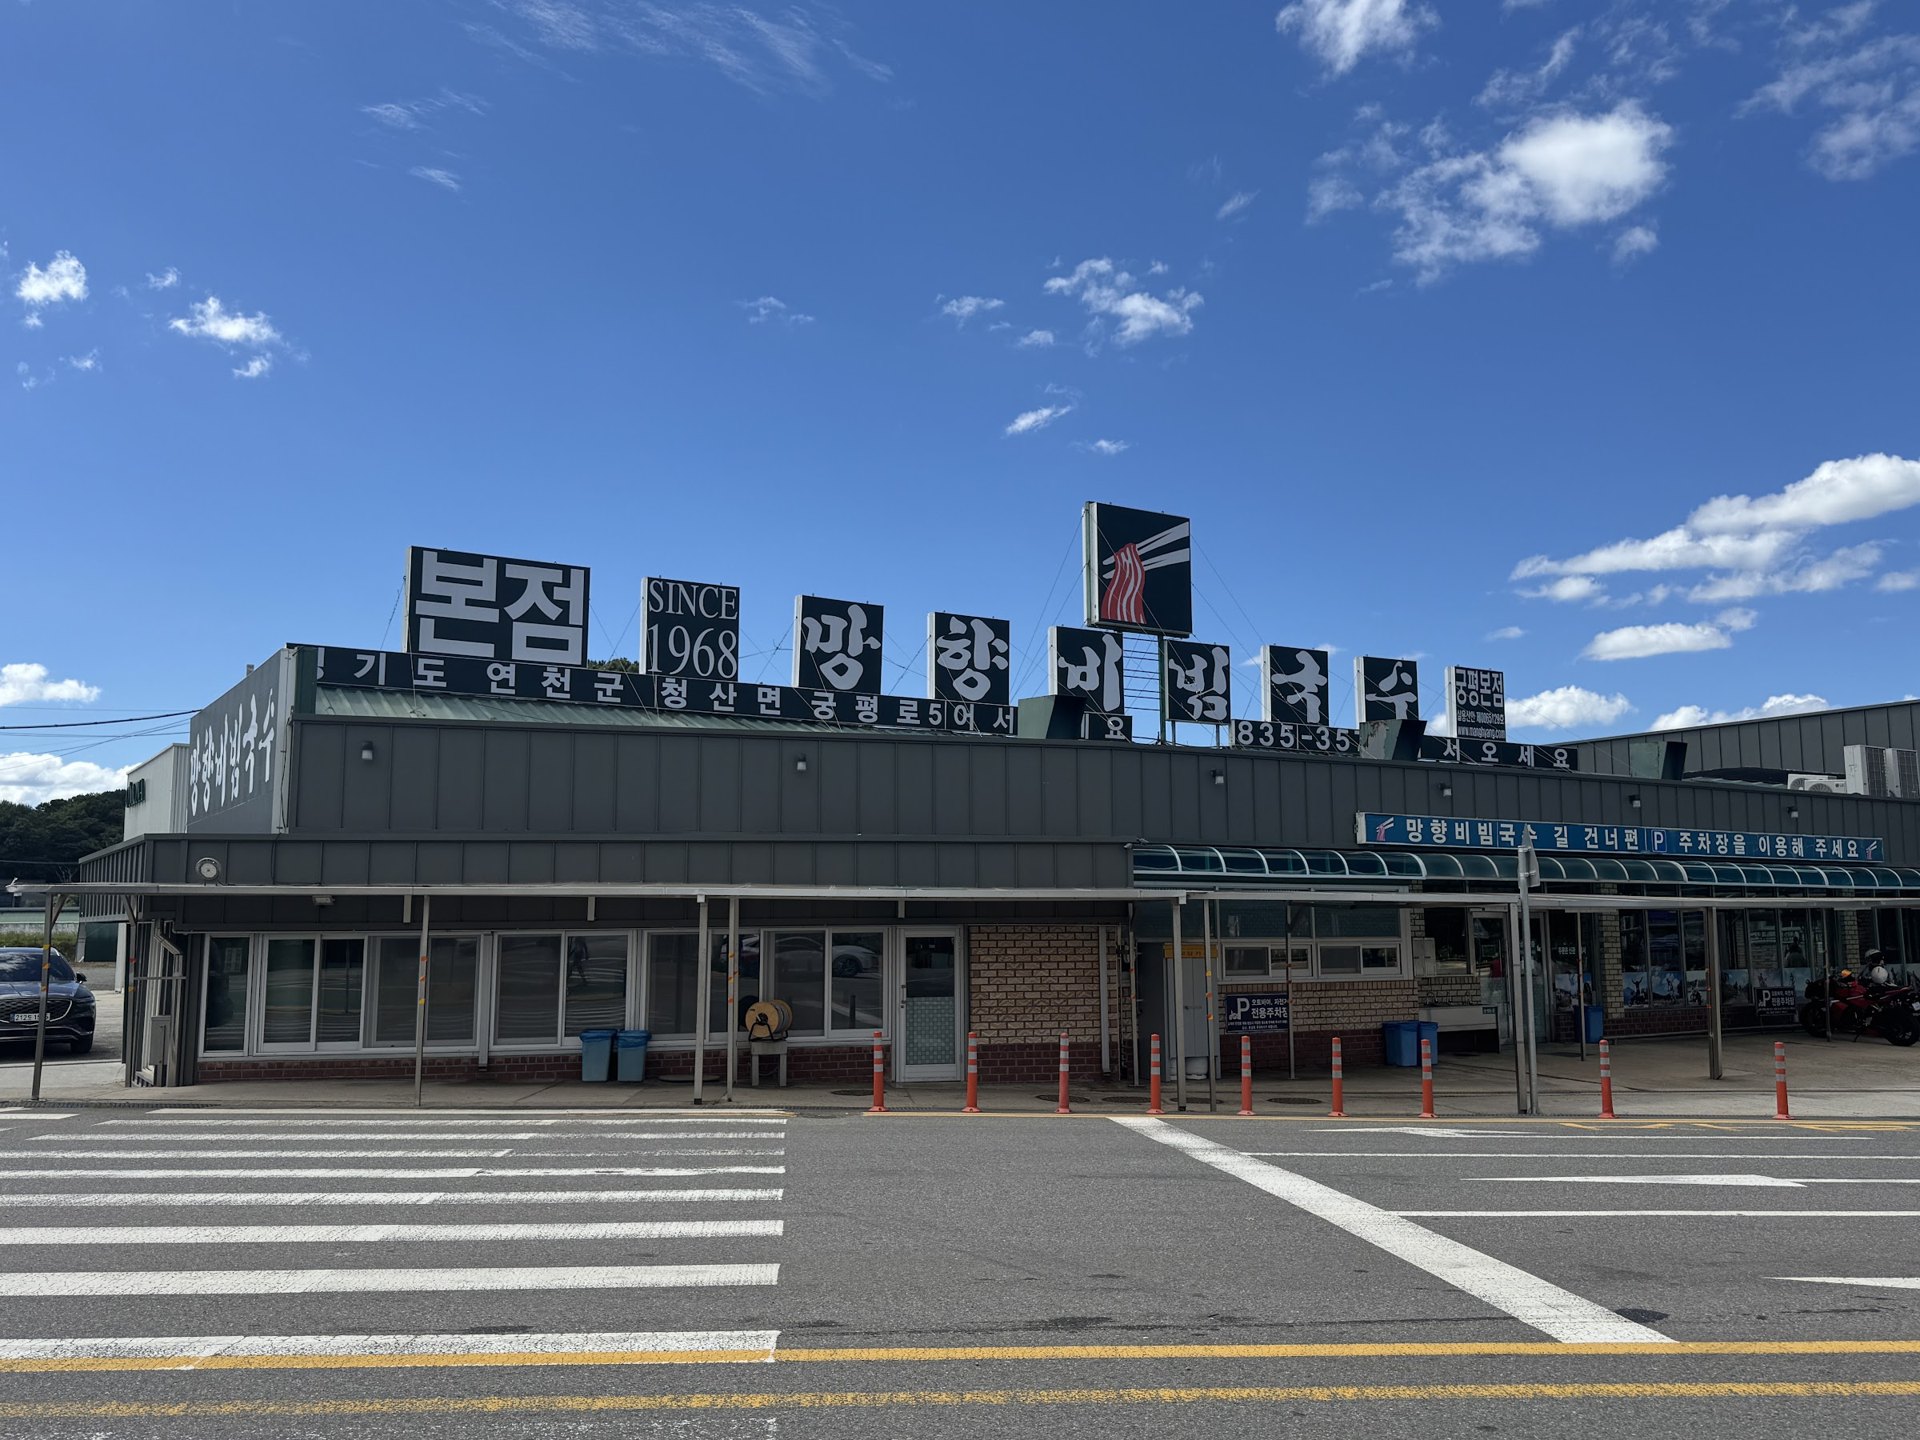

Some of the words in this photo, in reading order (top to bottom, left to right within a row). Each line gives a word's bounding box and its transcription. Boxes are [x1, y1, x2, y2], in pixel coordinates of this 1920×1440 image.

[415, 550, 585, 666] 본점
[649, 580, 738, 620] SINCE
[647, 623, 738, 678] 1968
[1455, 668, 1504, 708] 궁평본점
[1553, 825, 1569, 849] 길
[1584, 826, 1639, 851] 건너편
[1678, 831, 1747, 855] 주차장을
[1758, 835, 1804, 858] 이용해
[1815, 838, 1859, 859] 주세요
